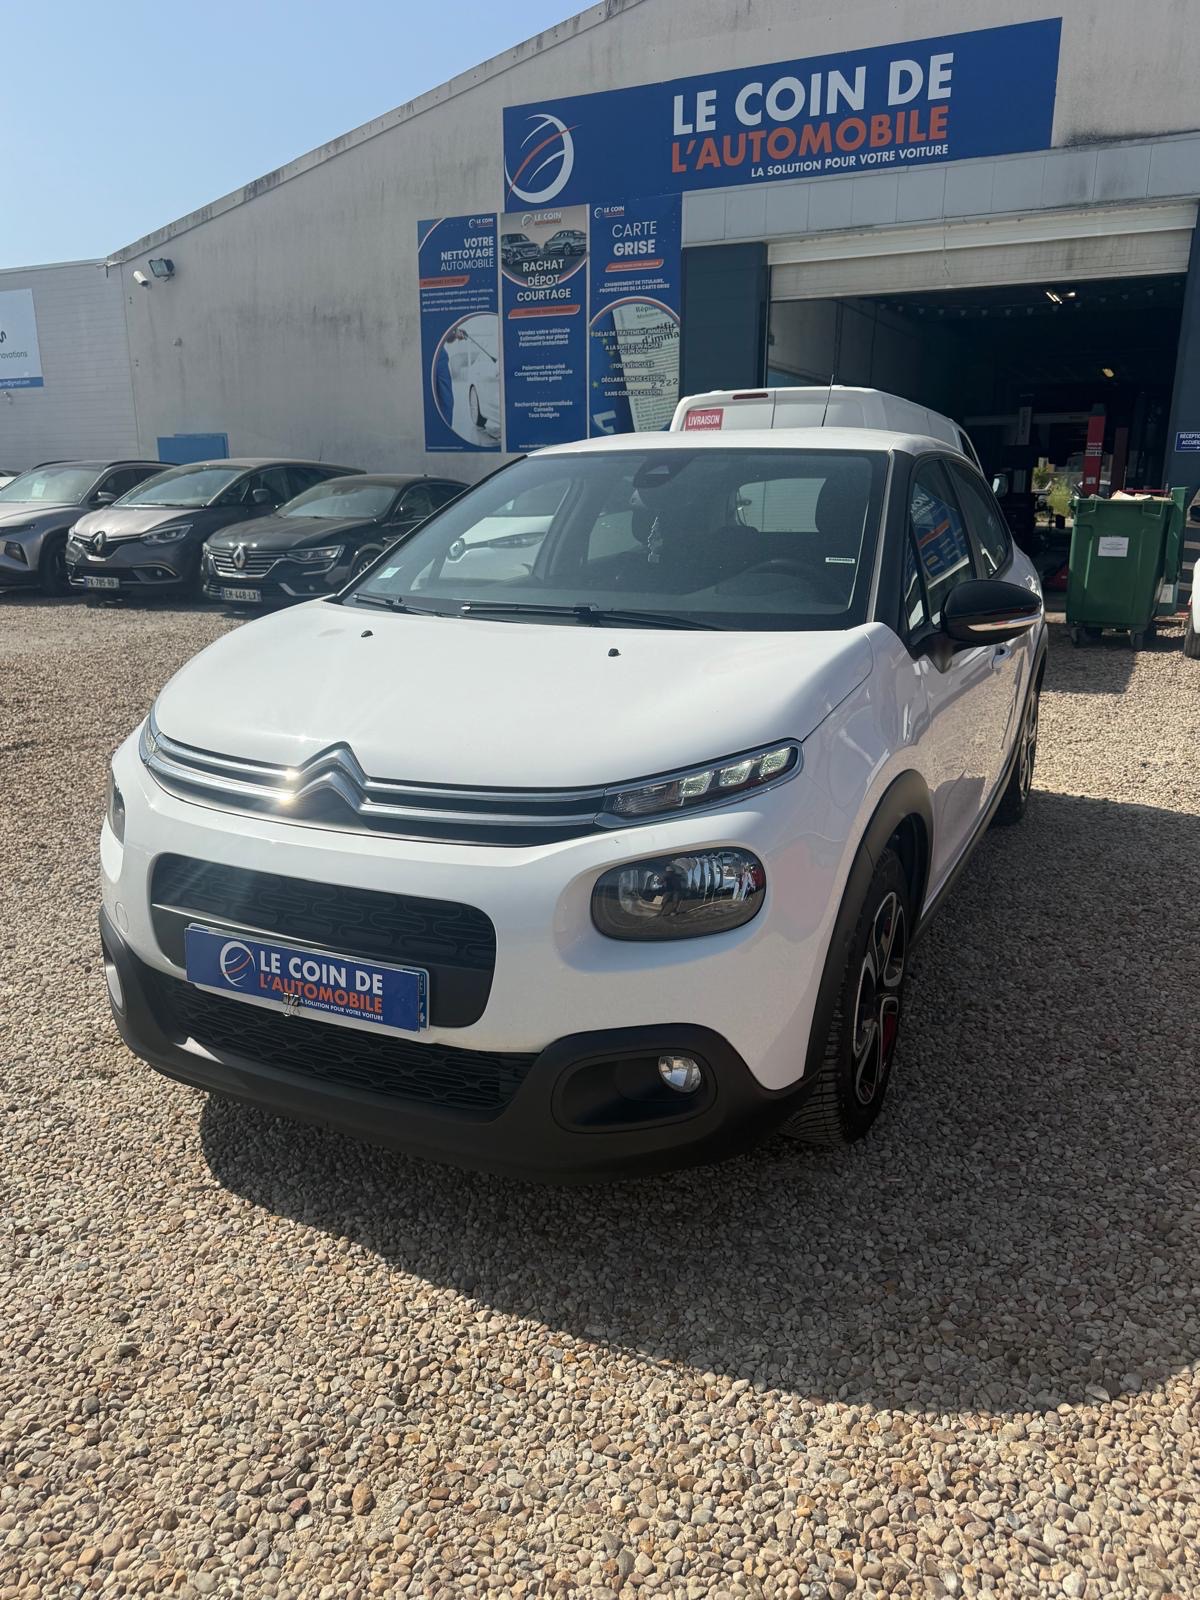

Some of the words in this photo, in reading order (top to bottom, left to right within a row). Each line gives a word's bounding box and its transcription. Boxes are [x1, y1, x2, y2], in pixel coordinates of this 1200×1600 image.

[673, 88, 717, 136] LE
[735, 65, 867, 126] COIN
[887, 52, 954, 106] DE
[671, 105, 949, 173] L'AUTOMOBILE
[751, 166, 764, 178] LA
[767, 160, 822, 176] SOLUTION
[824, 155, 856, 169] POUR
[860, 149, 895, 165] VOTRE
[899, 144, 949, 160] VOITURE
[543, 211, 562, 220] COIN
[612, 221, 657, 238] CARTE
[463, 236, 494, 248] VOTRE
[613, 239, 656, 256] GRISE
[440, 247, 494, 260] NETTOYAGE
[440, 258, 494, 271] AUTOMOBILE
[522, 259, 565, 272] RACHAT
[527, 273, 560, 286] DÉPOT
[516, 288, 571, 301] COURTAGE
[688, 414, 720, 427] LIVRAISON
[260, 950, 281, 974] LE
[288, 956, 347, 988] COIN
[355, 970, 383, 996] DE
[259, 973, 383, 1013] L'AUTOMOBILE
[305, 999, 330, 1010] SOLUTION
[330, 1005, 345, 1013] POUR
[345, 1008, 361, 1017] VOTRE
[362, 1011, 384, 1021] VOITURE
